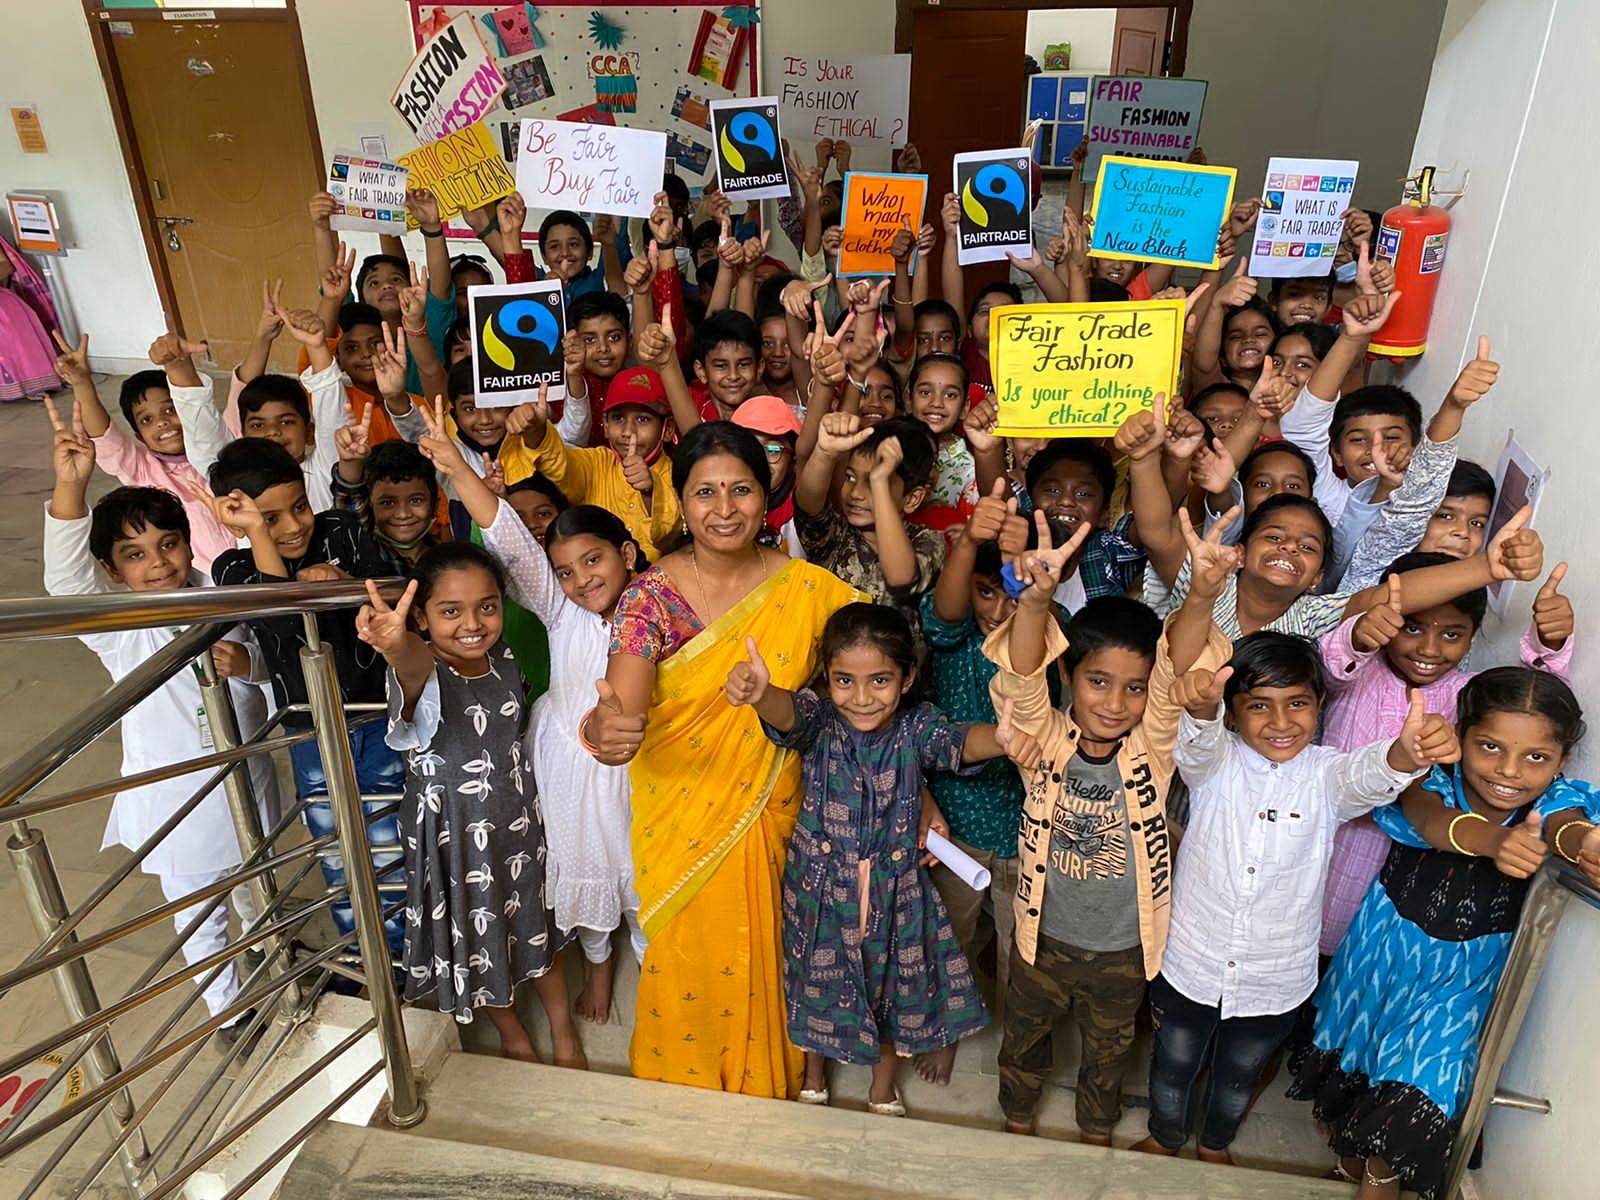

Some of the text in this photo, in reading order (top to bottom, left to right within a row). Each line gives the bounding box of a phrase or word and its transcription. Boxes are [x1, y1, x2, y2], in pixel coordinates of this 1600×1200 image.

[591, 55, 632, 75] CCA
[395, 25, 467, 133] FASHION
[1096, 80, 1143, 102] FAIR
[782, 83, 859, 110] FASHION
[814, 116, 883, 139] ETHICAL
[1120, 107, 1190, 126] FASHION
[526, 121, 617, 161] Be Fair
[1090, 125, 1192, 149] SUSTAINABLE
[359, 171, 397, 187] WHAT IS
[538, 157, 640, 206] Buy Fair
[723, 173, 783, 189] FAIRTRADE
[1113, 168, 1204, 199] Sustainable
[349, 187, 404, 206] FAIR TRADE?
[862, 183, 899, 209] Who
[1125, 193, 1185, 218] Fashion
[1295, 199, 1338, 216] WHAT IS
[863, 196, 911, 225] made
[872, 228, 896, 242] my
[963, 230, 1027, 245] FAIRTRADE
[1131, 218, 1170, 238] is the
[1280, 219, 1343, 237] FAIR TRADE?
[1103, 231, 1188, 259] New Black
[1008, 311, 1153, 342] Fair Trade
[1033, 343, 1134, 372] Fashion
[483, 371, 561, 389] FAIRTRADE
[1002, 378, 1022, 402] Is
[1031, 386, 1072, 410] your
[1051, 850, 1093, 880] SURF
